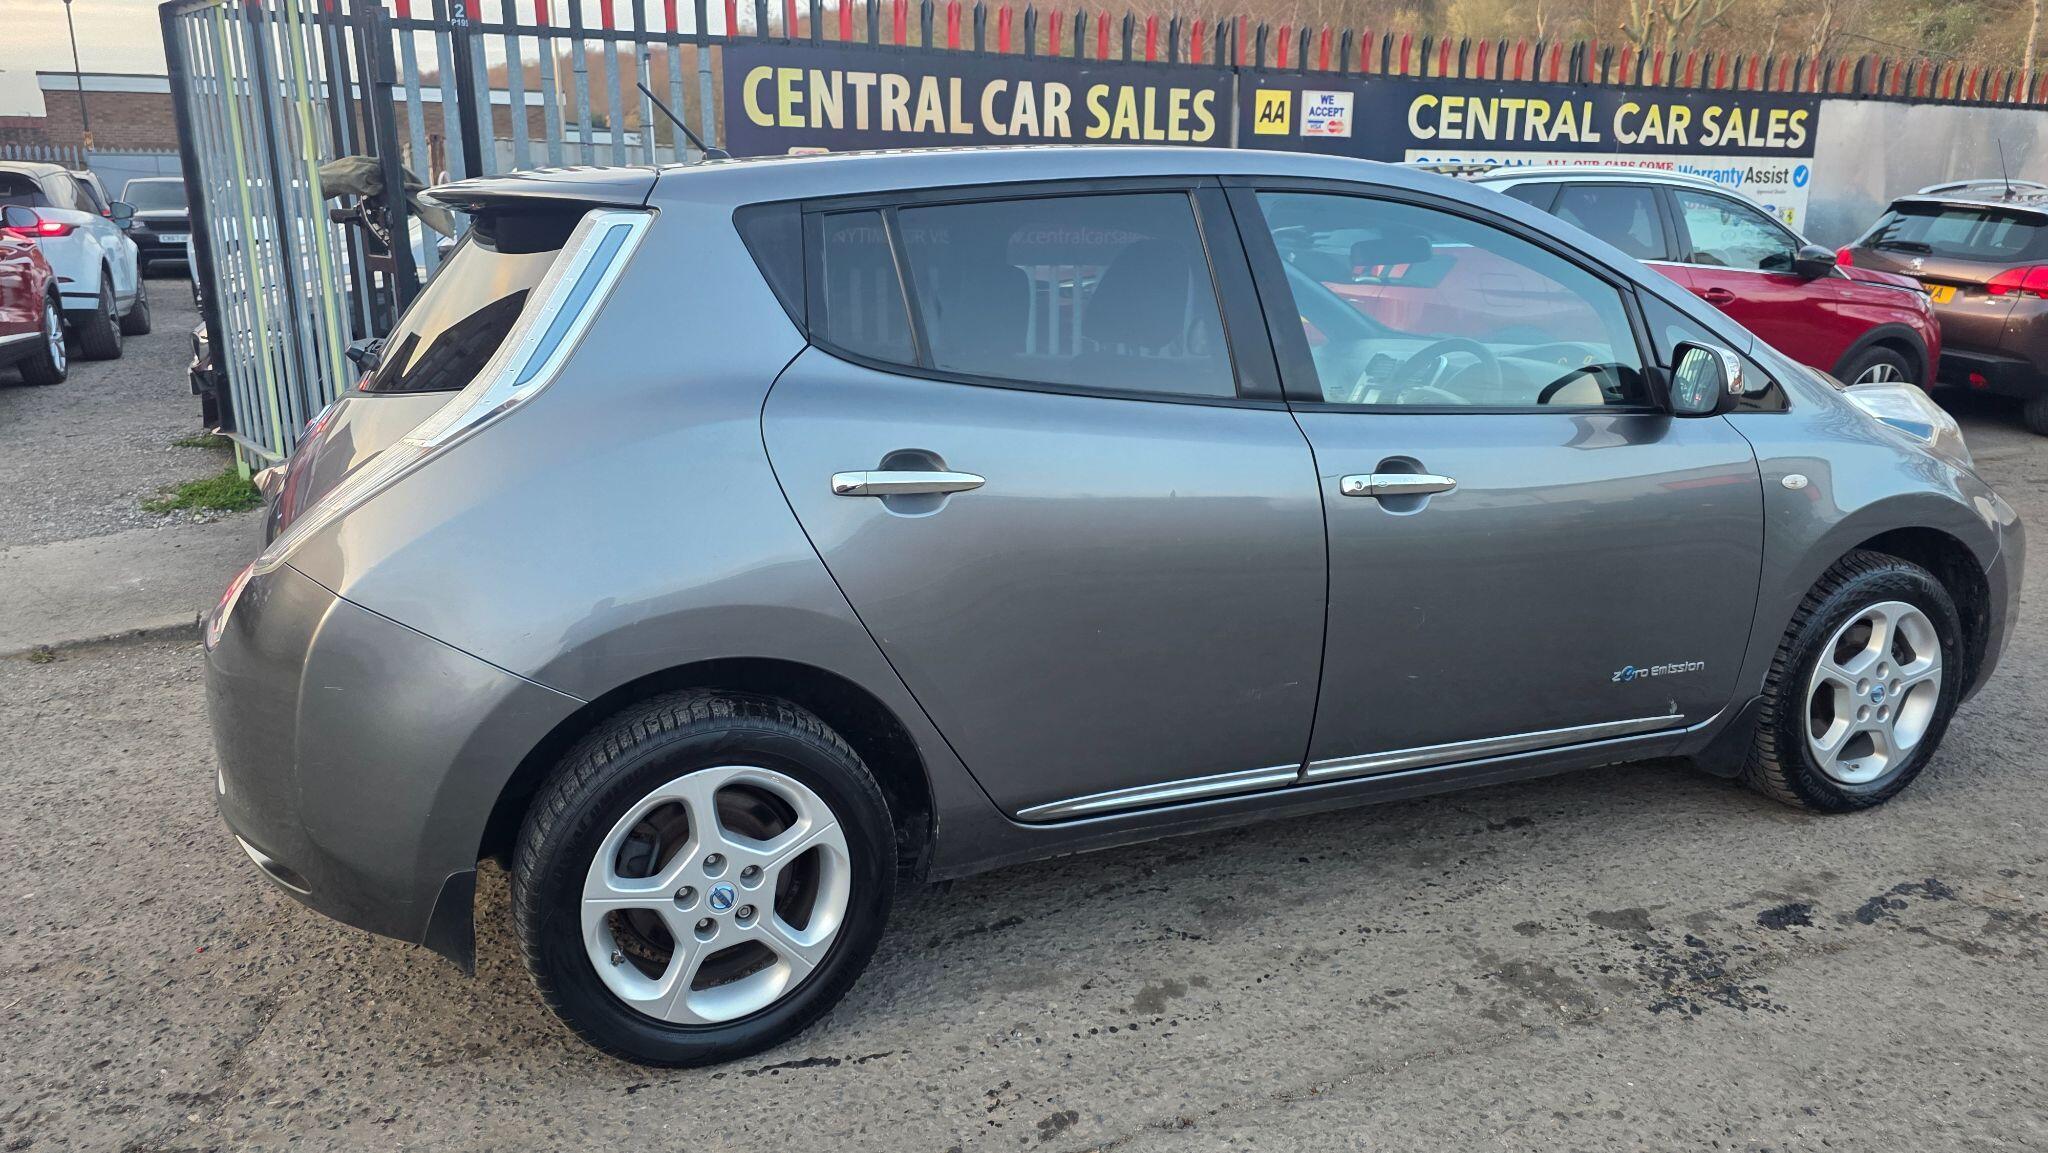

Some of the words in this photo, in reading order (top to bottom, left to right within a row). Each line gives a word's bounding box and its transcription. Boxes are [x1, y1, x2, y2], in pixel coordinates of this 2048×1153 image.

[454, 3, 465, 18] 2
[743, 66, 974, 134] CENTRAL
[980, 79, 1072, 138] CAR
[1085, 84, 1216, 142] SALES
[1320, 95, 1335, 105] WE
[1259, 100, 1285, 123] AA
[1309, 107, 1345, 117] ACCEPT
[1408, 94, 1601, 142] CENTRAL
[1613, 102, 1692, 144] CAR
[1699, 106, 1809, 149] SALES
[1639, 161, 1674, 171] COME
[1651, 661, 1705, 676] Emission
